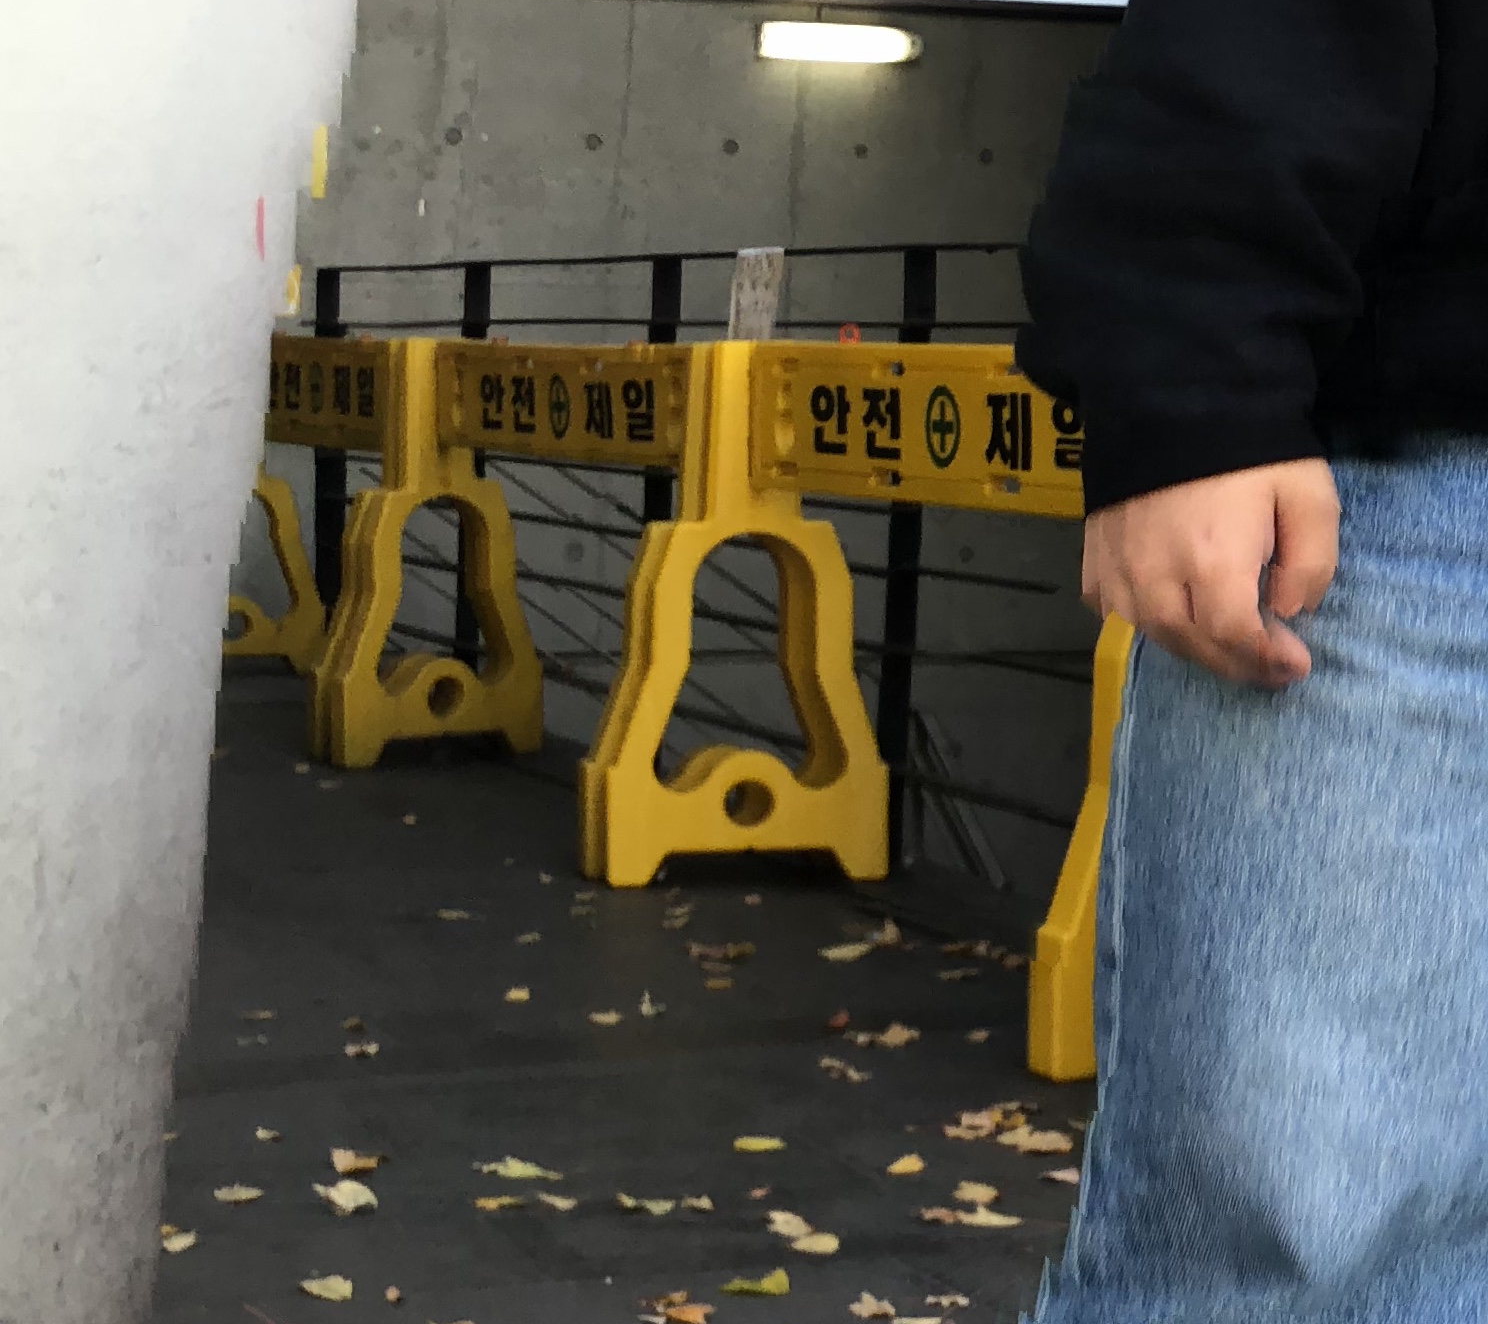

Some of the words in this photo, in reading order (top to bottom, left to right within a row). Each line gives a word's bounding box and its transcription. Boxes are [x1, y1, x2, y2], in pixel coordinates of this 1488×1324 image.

[479, 372, 537, 434] 안전
[583, 377, 656, 442] 제일
[809, 384, 902, 460] 안전
